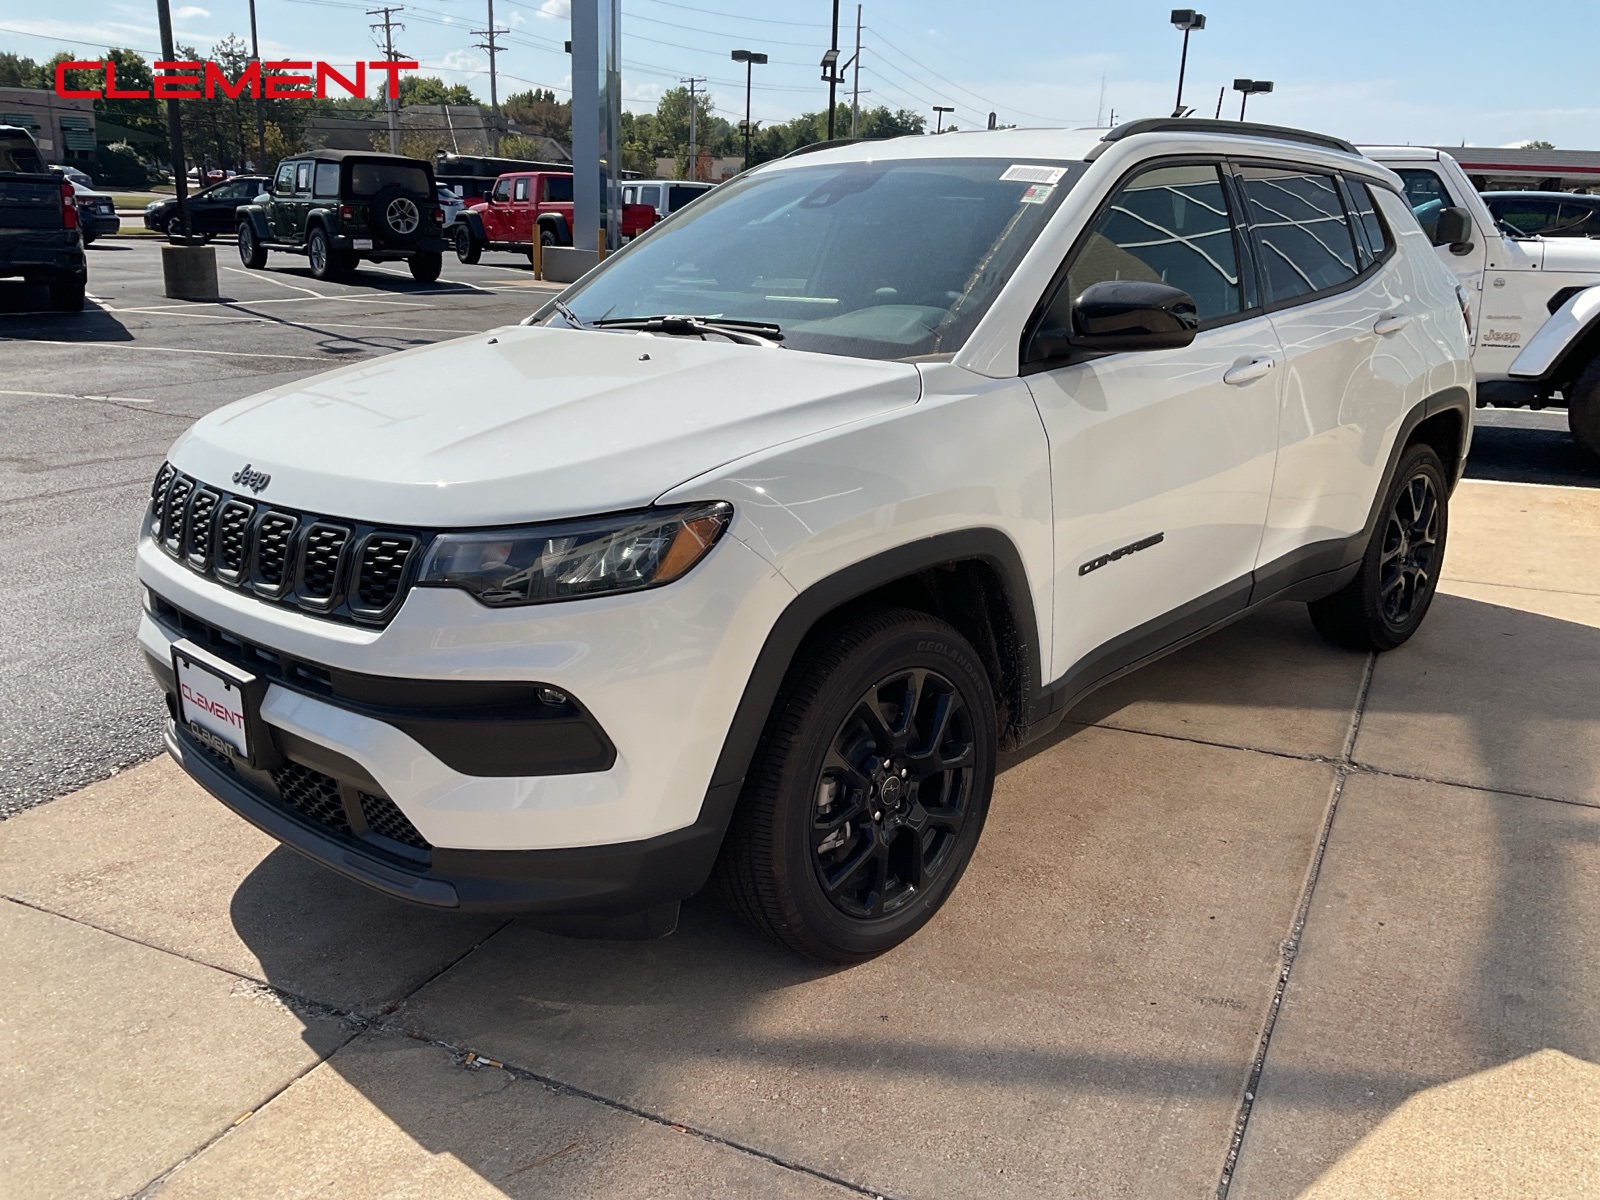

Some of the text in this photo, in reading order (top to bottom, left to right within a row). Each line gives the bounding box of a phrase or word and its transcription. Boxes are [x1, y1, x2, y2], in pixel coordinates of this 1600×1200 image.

[1484, 329, 1520, 343] Jeep
[232, 463, 271, 494] Jeep
[1079, 531, 1165, 577] COMPASS
[916, 640, 985, 692] GEOLANDAR
[181, 683, 245, 729] CLEMENT
[190, 721, 234, 757] CLEMENT
